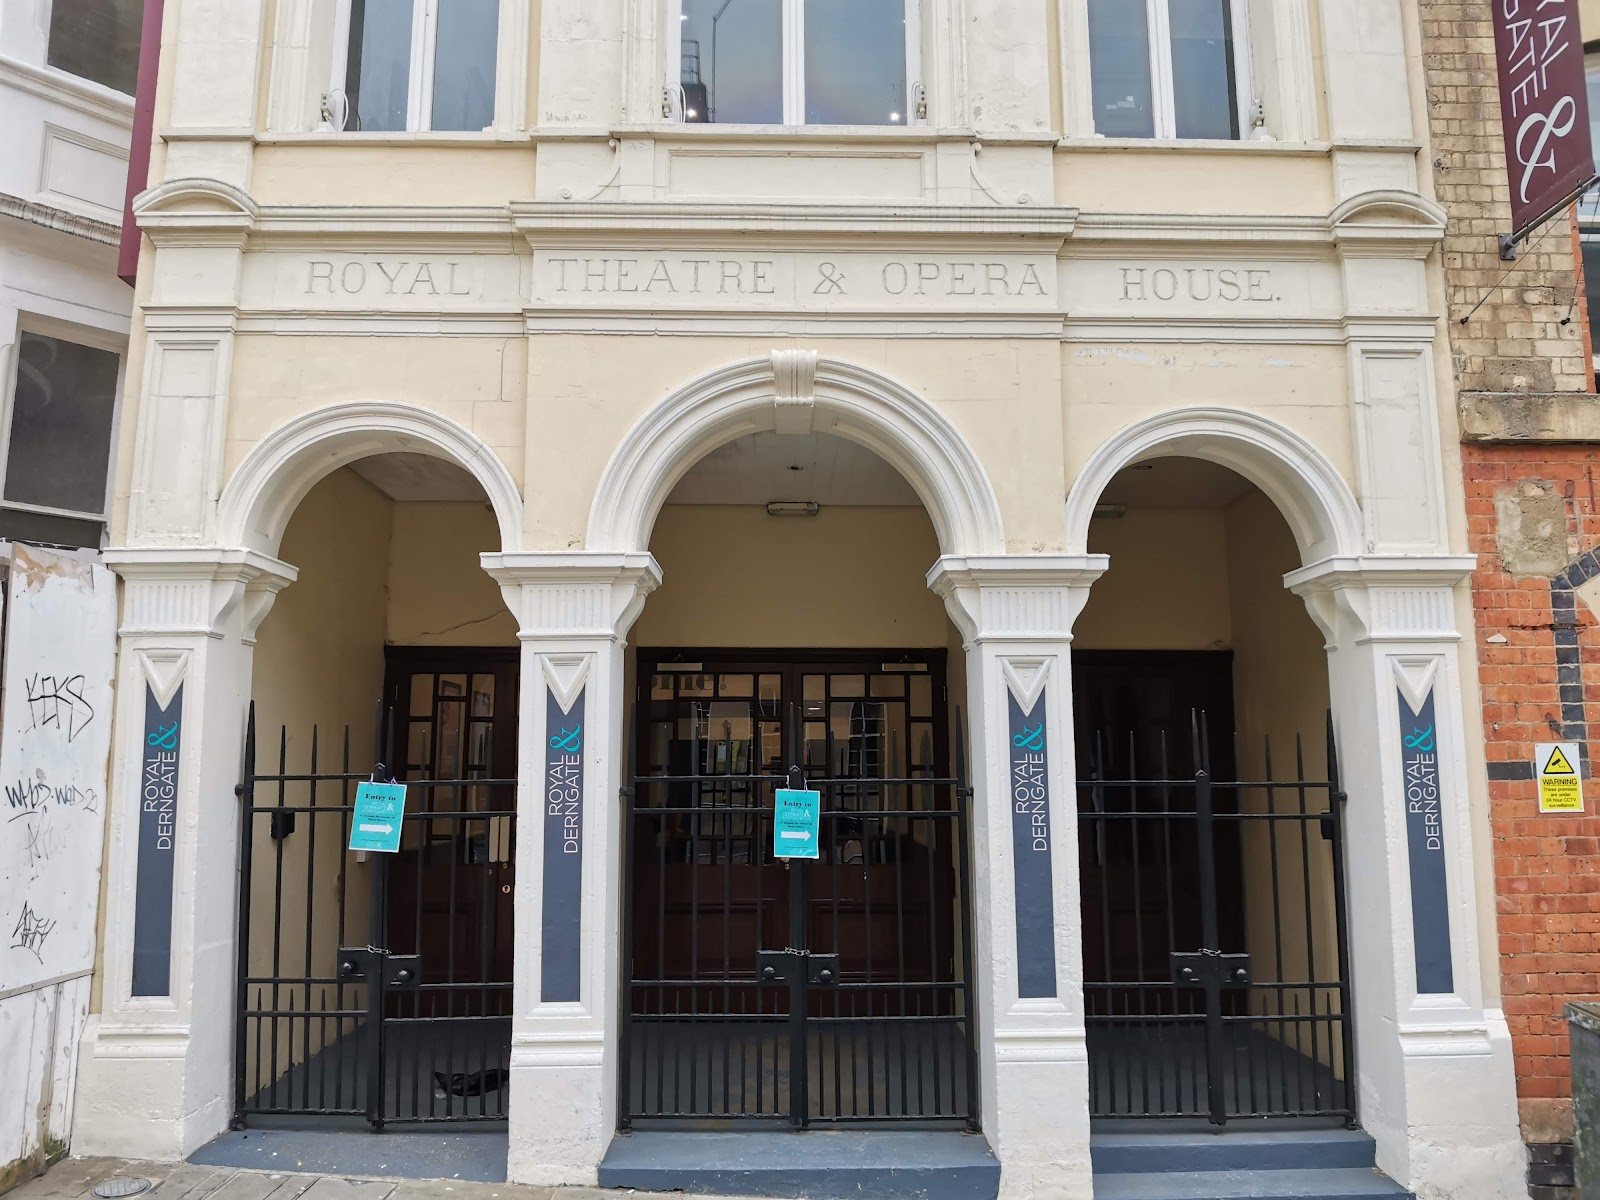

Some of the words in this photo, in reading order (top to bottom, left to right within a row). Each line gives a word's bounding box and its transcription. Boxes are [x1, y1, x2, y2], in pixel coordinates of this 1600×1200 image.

[1536, 0, 1569, 91] AL
[1515, 95, 1576, 204] &
[303, 261, 471, 295] ROYAL
[548, 258, 775, 294] THEATRE
[812, 261, 848, 295] &
[881, 261, 1048, 296] OPERA
[1118, 267, 1282, 302] HOUSE.
[147, 720, 178, 750] &
[549, 723, 581, 752] &
[1012, 722, 1043, 751] &
[1404, 722, 1433, 751] &
[144, 752, 161, 812] ROYAL
[157, 751, 176, 850] DERNGATE
[365, 793, 386, 802] Entry
[549, 754, 564, 816] ROYAL
[563, 754, 580, 853] DERNGATE
[784, 800, 802, 808] Entry
[1014, 753, 1030, 814] ROYAL
[1029, 753, 1048, 851] DERNGATE
[1406, 753, 1423, 813] ROYAL
[1420, 753, 1441, 850] DERNGATE
